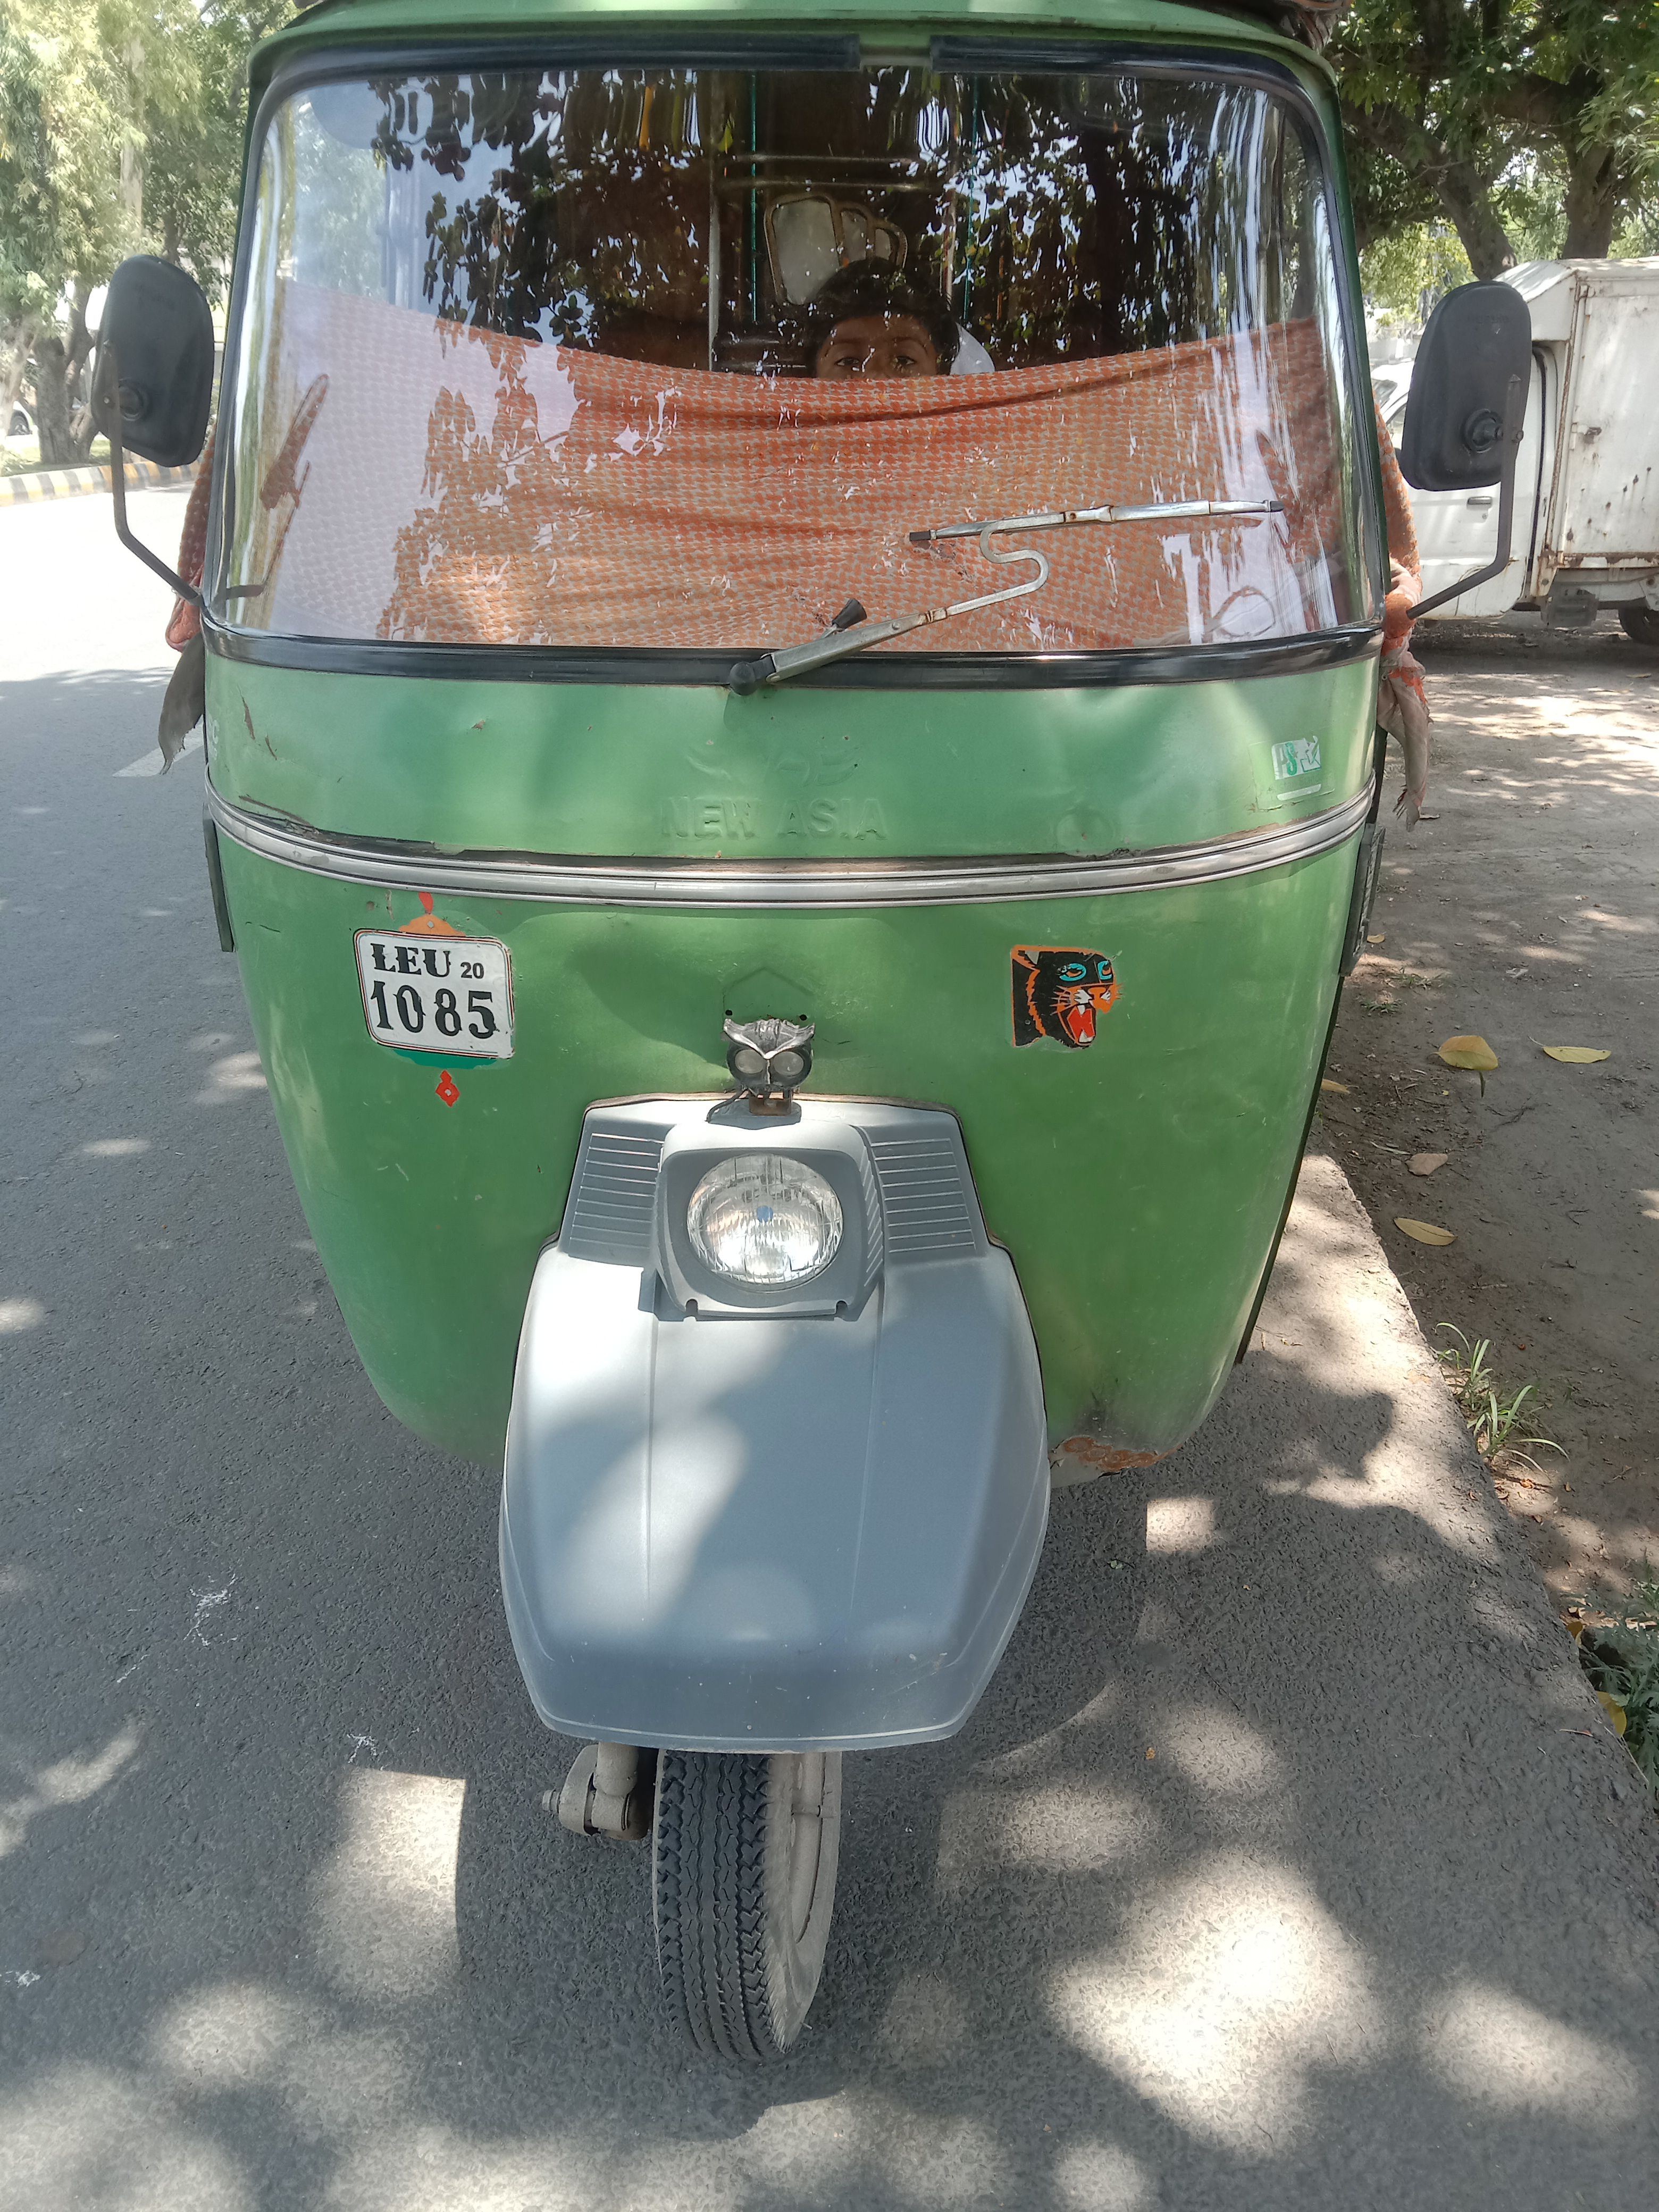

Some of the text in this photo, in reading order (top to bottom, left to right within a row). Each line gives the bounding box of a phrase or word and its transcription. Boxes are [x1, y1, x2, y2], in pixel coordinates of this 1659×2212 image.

[660, 798, 760, 840] NEW
[370, 943, 485, 979] LEU 20
[370, 980, 497, 1040] 1085
